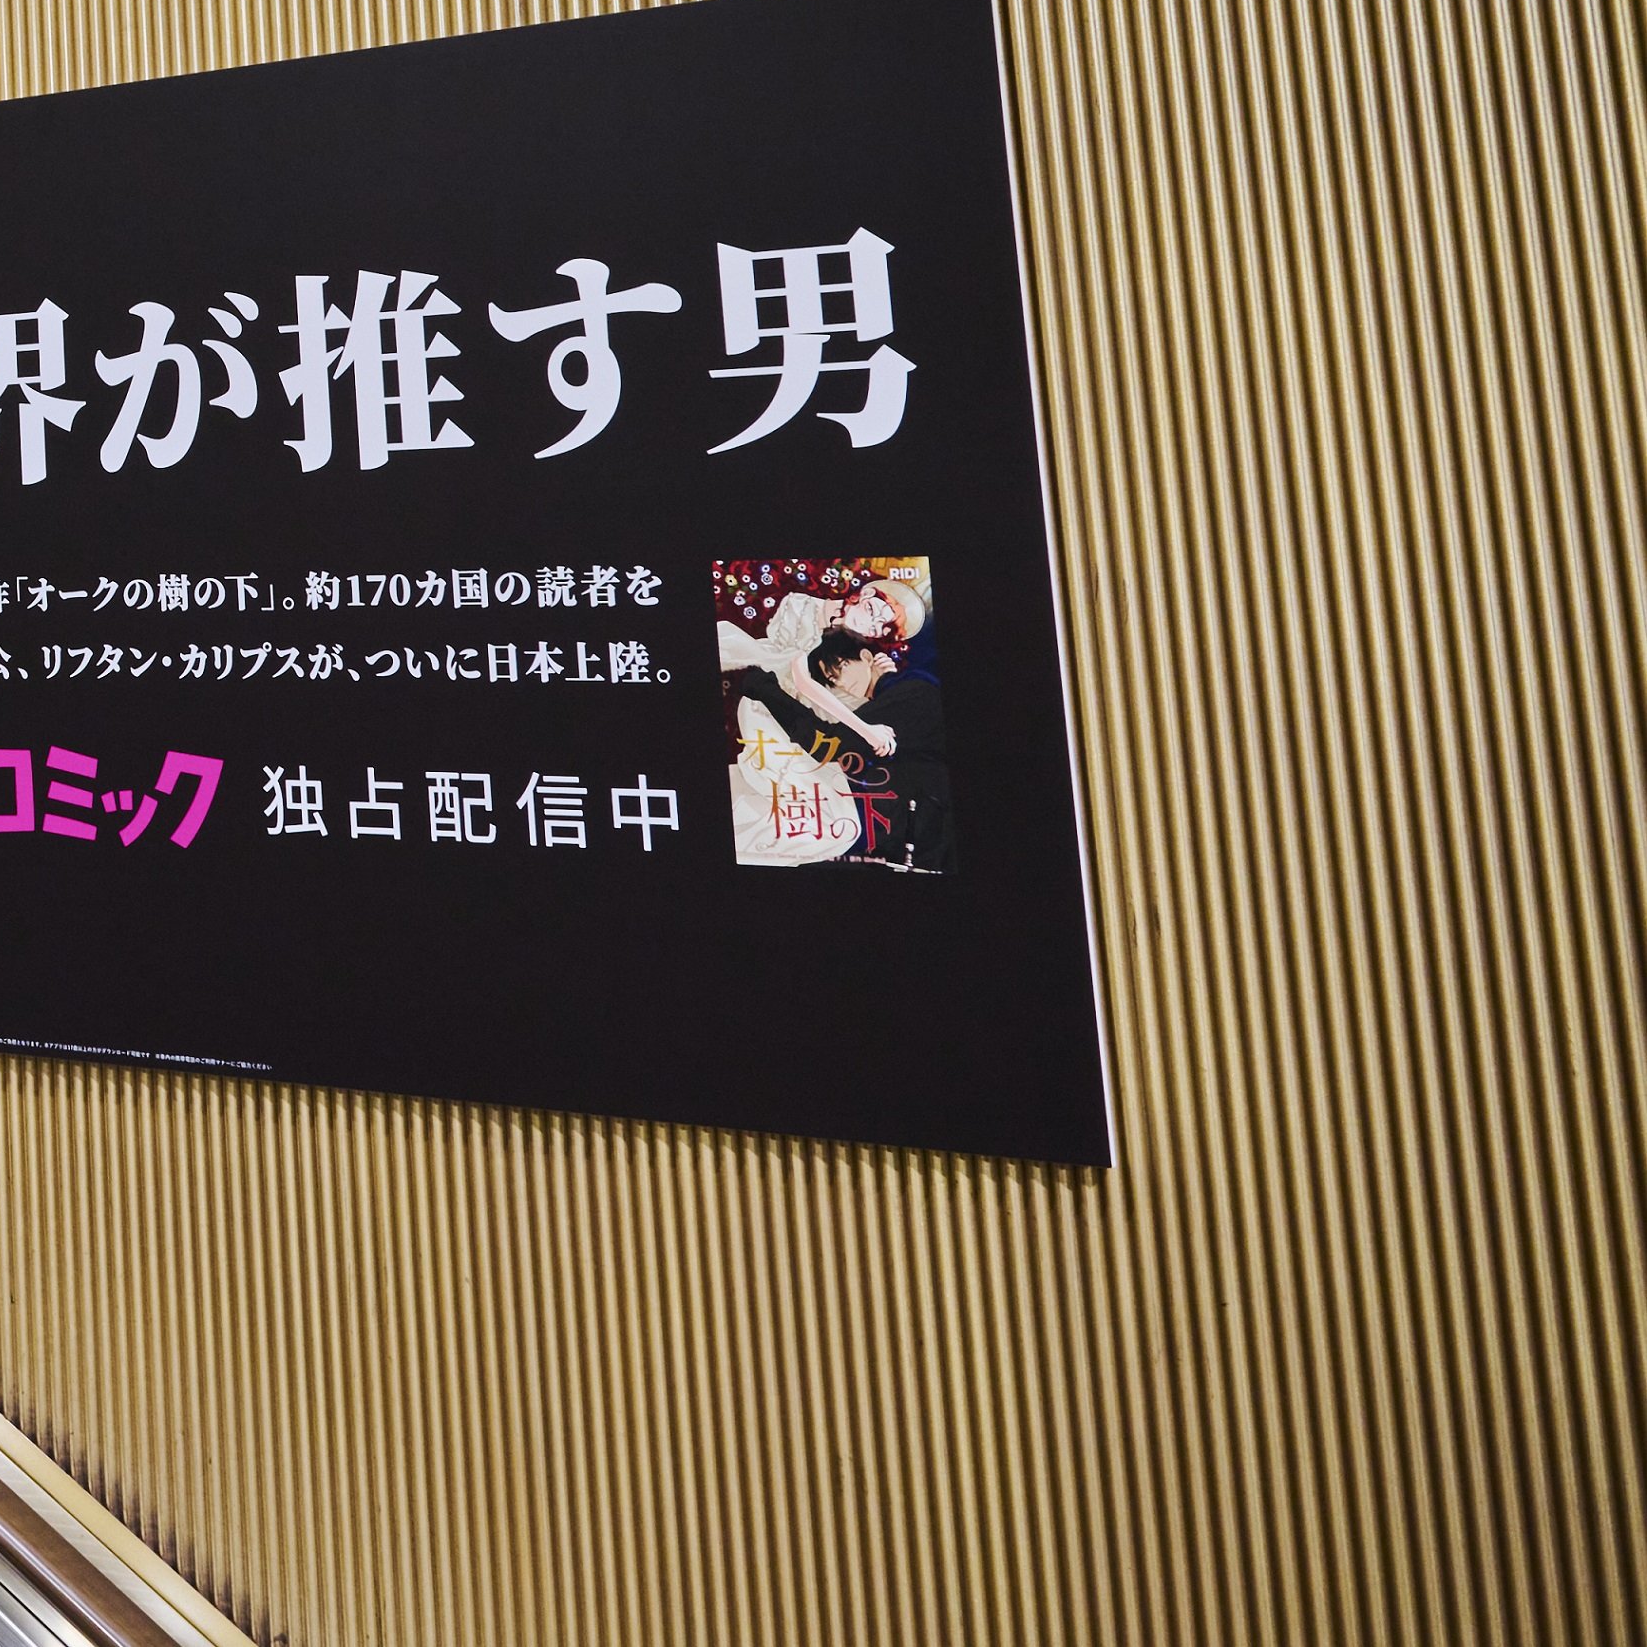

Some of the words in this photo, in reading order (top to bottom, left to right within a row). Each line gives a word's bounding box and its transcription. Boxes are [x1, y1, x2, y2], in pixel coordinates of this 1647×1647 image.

[889, 567, 921, 580] RIDI
[736, 728, 890, 786] オークの
[262, 765, 680, 852] 独占配信中
[766, 780, 899, 853] 樹の下
